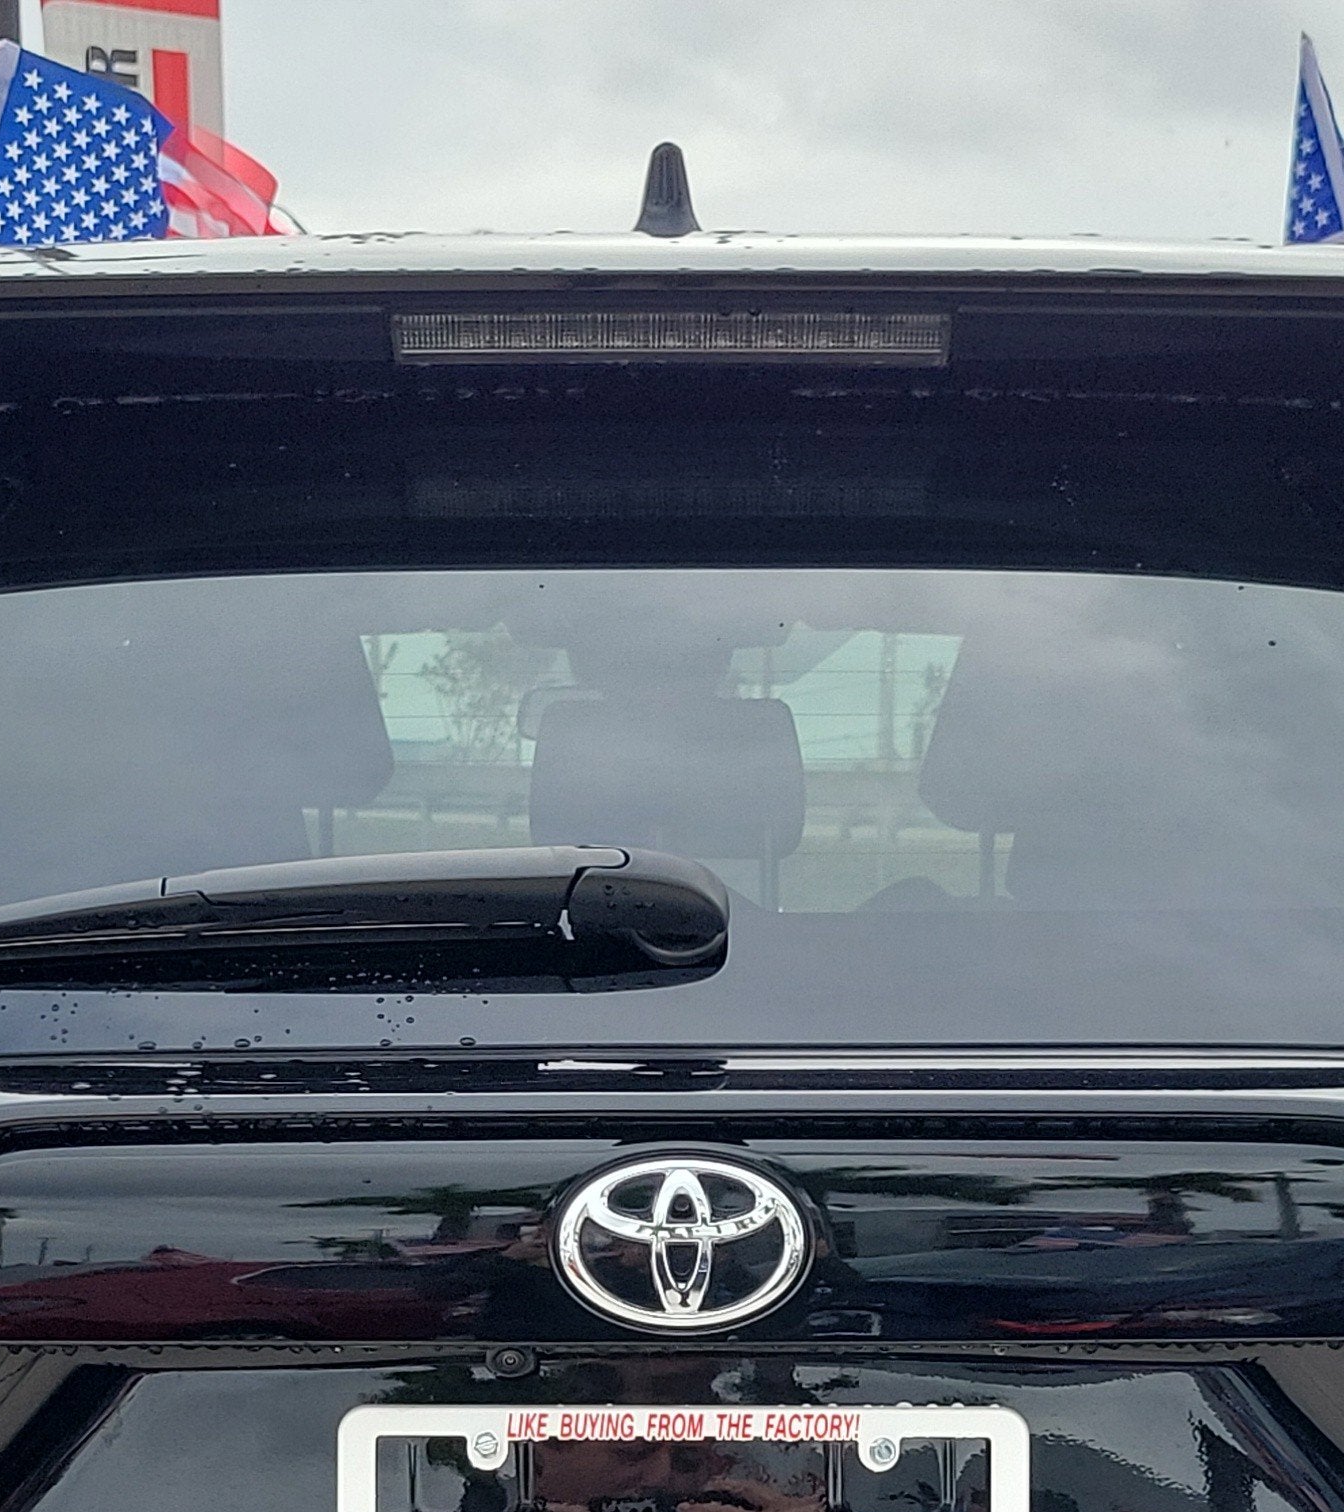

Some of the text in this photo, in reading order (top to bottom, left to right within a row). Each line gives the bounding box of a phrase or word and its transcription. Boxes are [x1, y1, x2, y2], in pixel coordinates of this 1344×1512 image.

[507, 1413, 861, 1439] LIKE BUYING FROM THE FACTORY!
